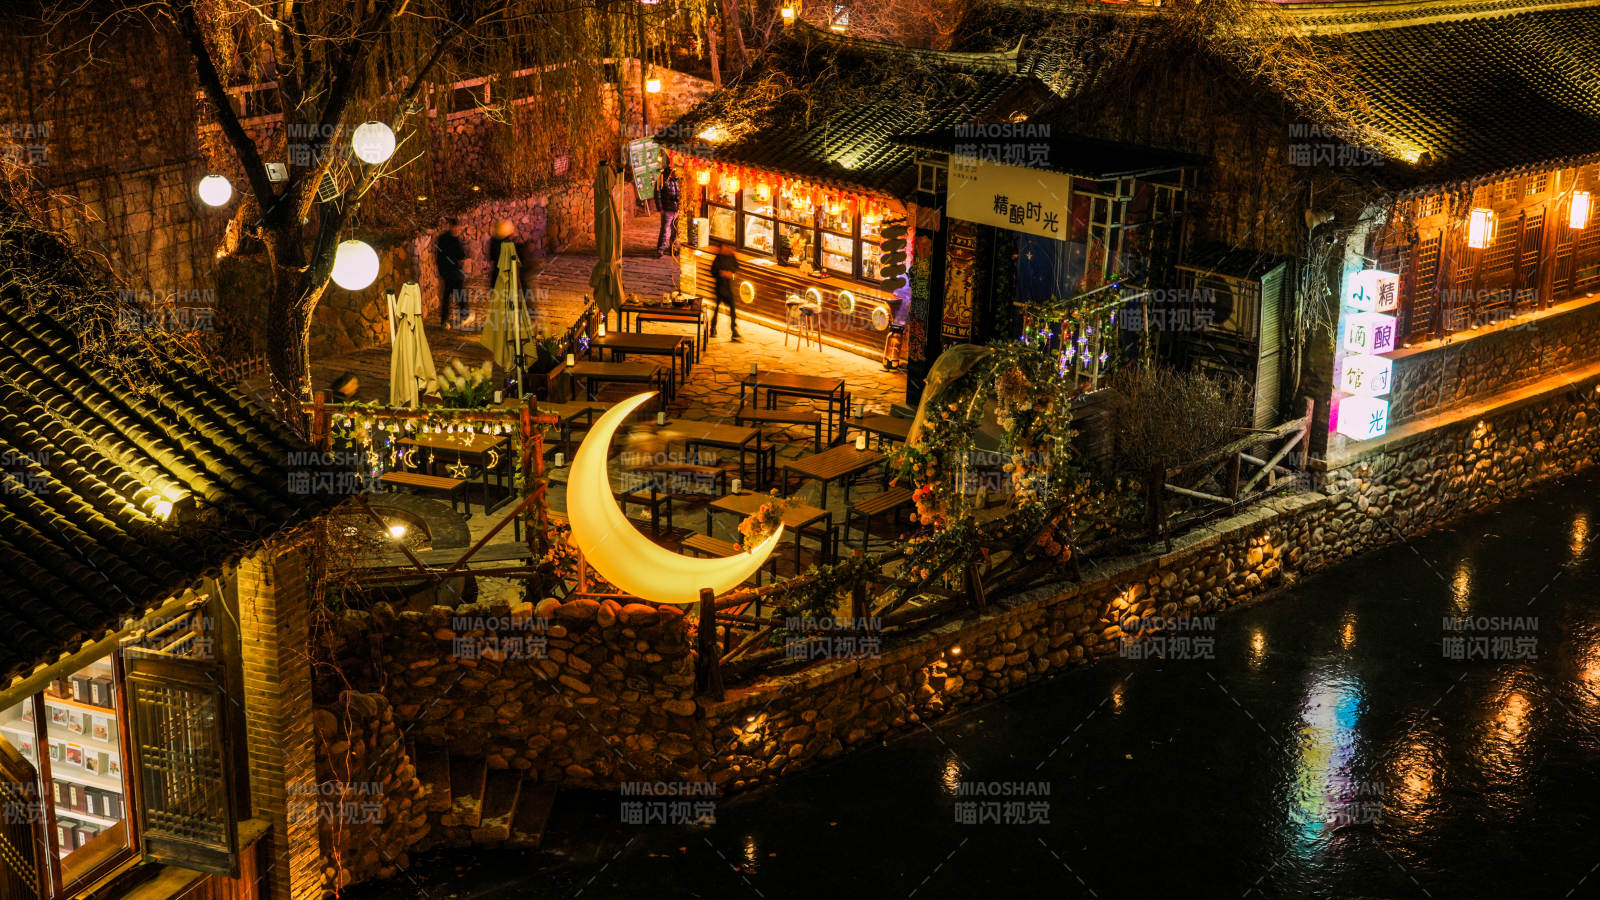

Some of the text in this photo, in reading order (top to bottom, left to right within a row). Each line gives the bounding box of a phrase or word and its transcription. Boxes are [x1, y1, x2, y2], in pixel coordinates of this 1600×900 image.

[993, 193, 1059, 233] 精酿时光
[943, 325, 957, 335] THE
